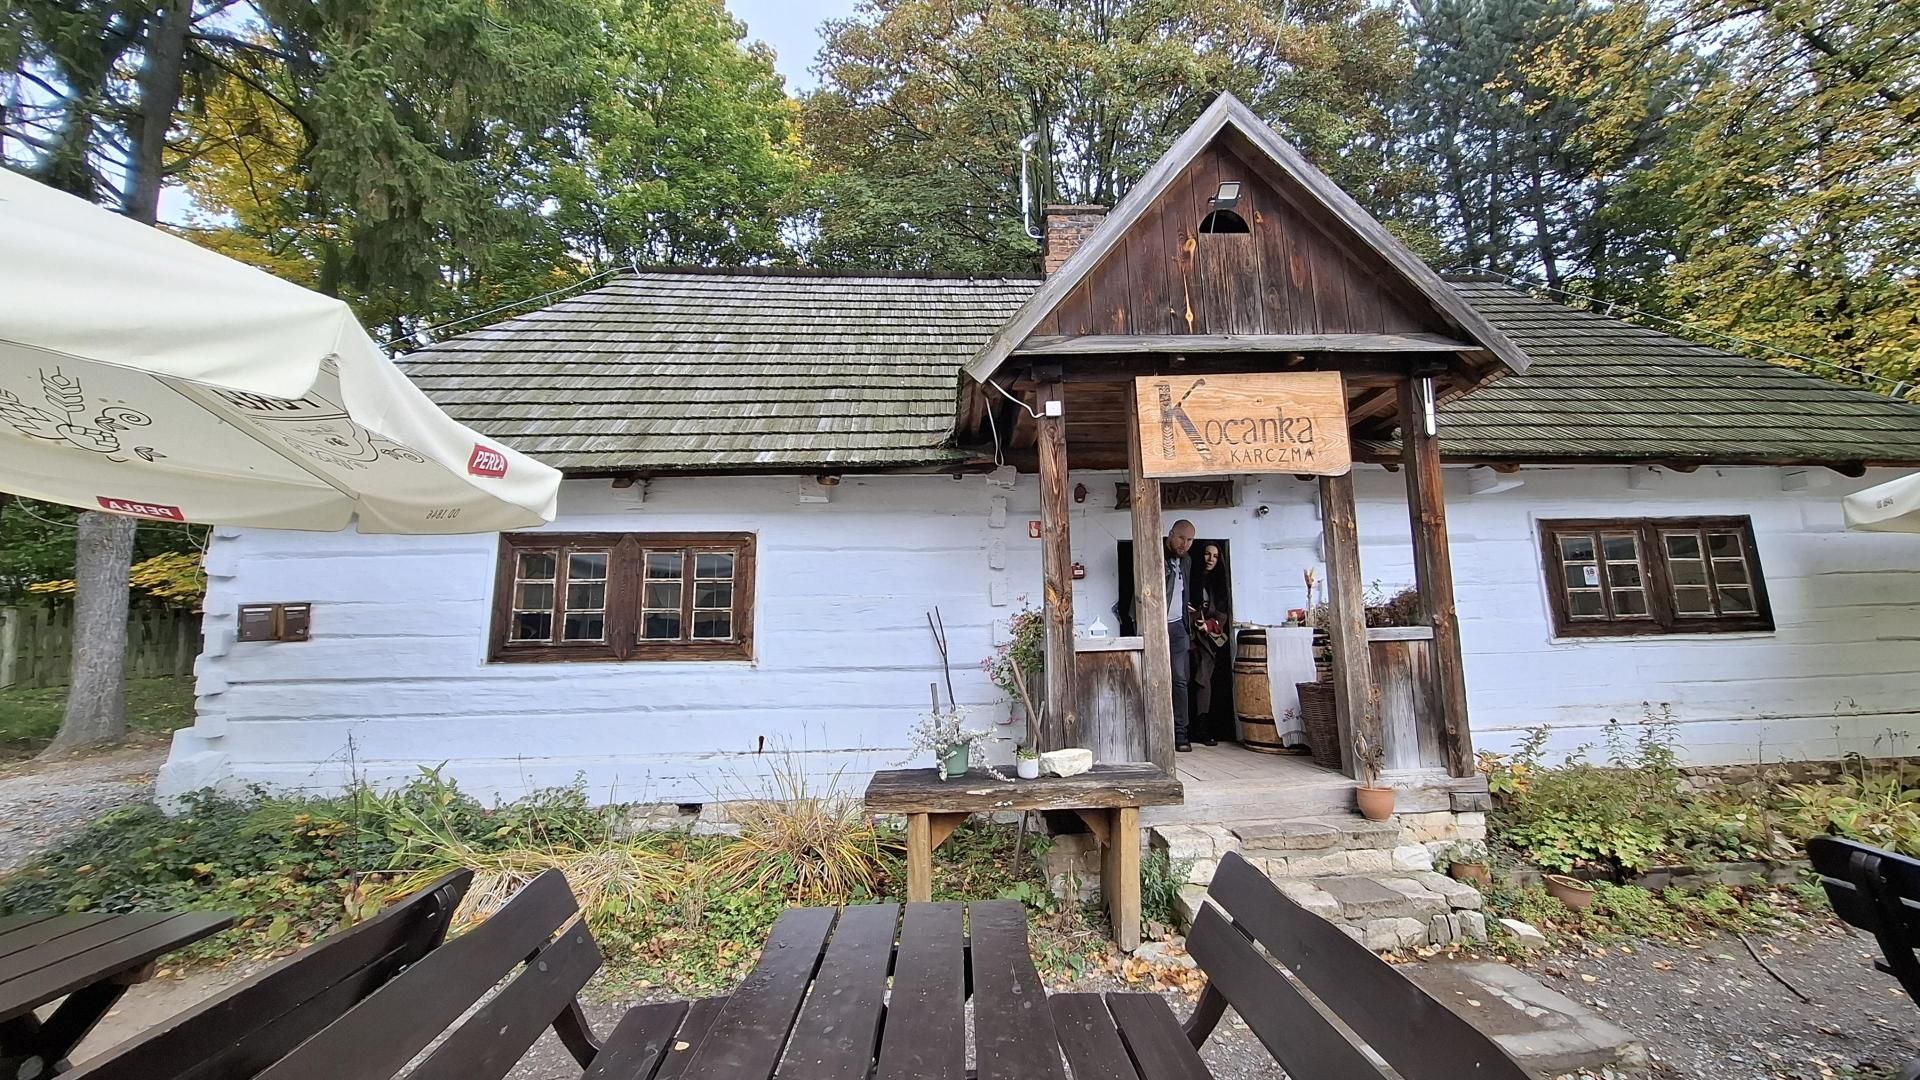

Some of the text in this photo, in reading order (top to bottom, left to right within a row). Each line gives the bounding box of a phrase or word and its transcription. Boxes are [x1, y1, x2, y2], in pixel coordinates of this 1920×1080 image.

[1154, 378, 1314, 465] Kocanka
[472, 450, 505, 471] PERŁA
[1230, 448, 1314, 463] KARCZMA
[1118, 482, 1233, 504] ZRASZA
